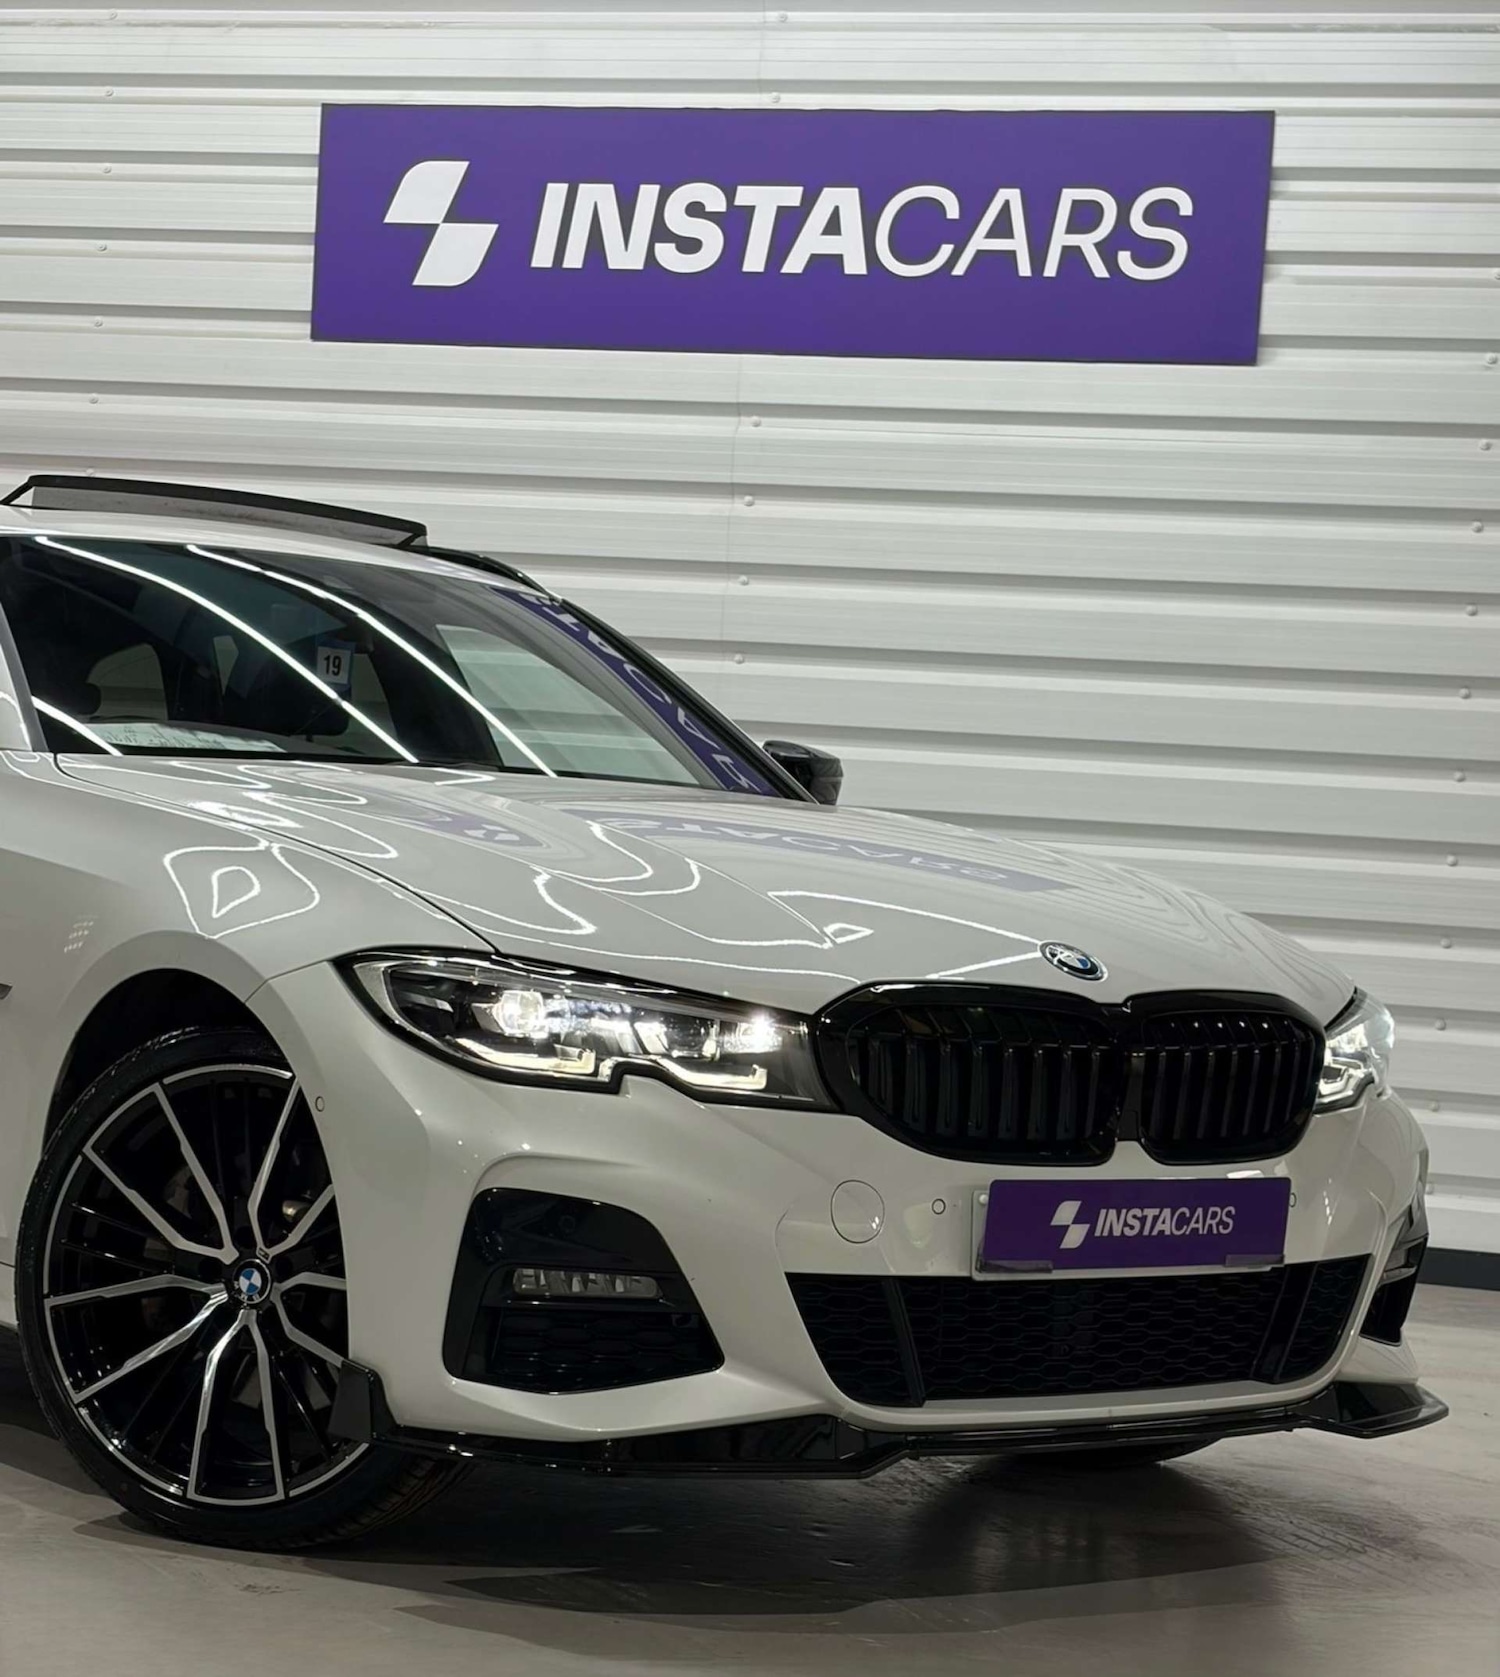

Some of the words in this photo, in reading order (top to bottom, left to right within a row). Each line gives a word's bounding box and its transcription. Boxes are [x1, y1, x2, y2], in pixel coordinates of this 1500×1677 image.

[531, 182, 1193, 281] INSTACARS
[323, 654, 342, 676] 19
[1094, 1206, 1235, 1237] INSTACARS
